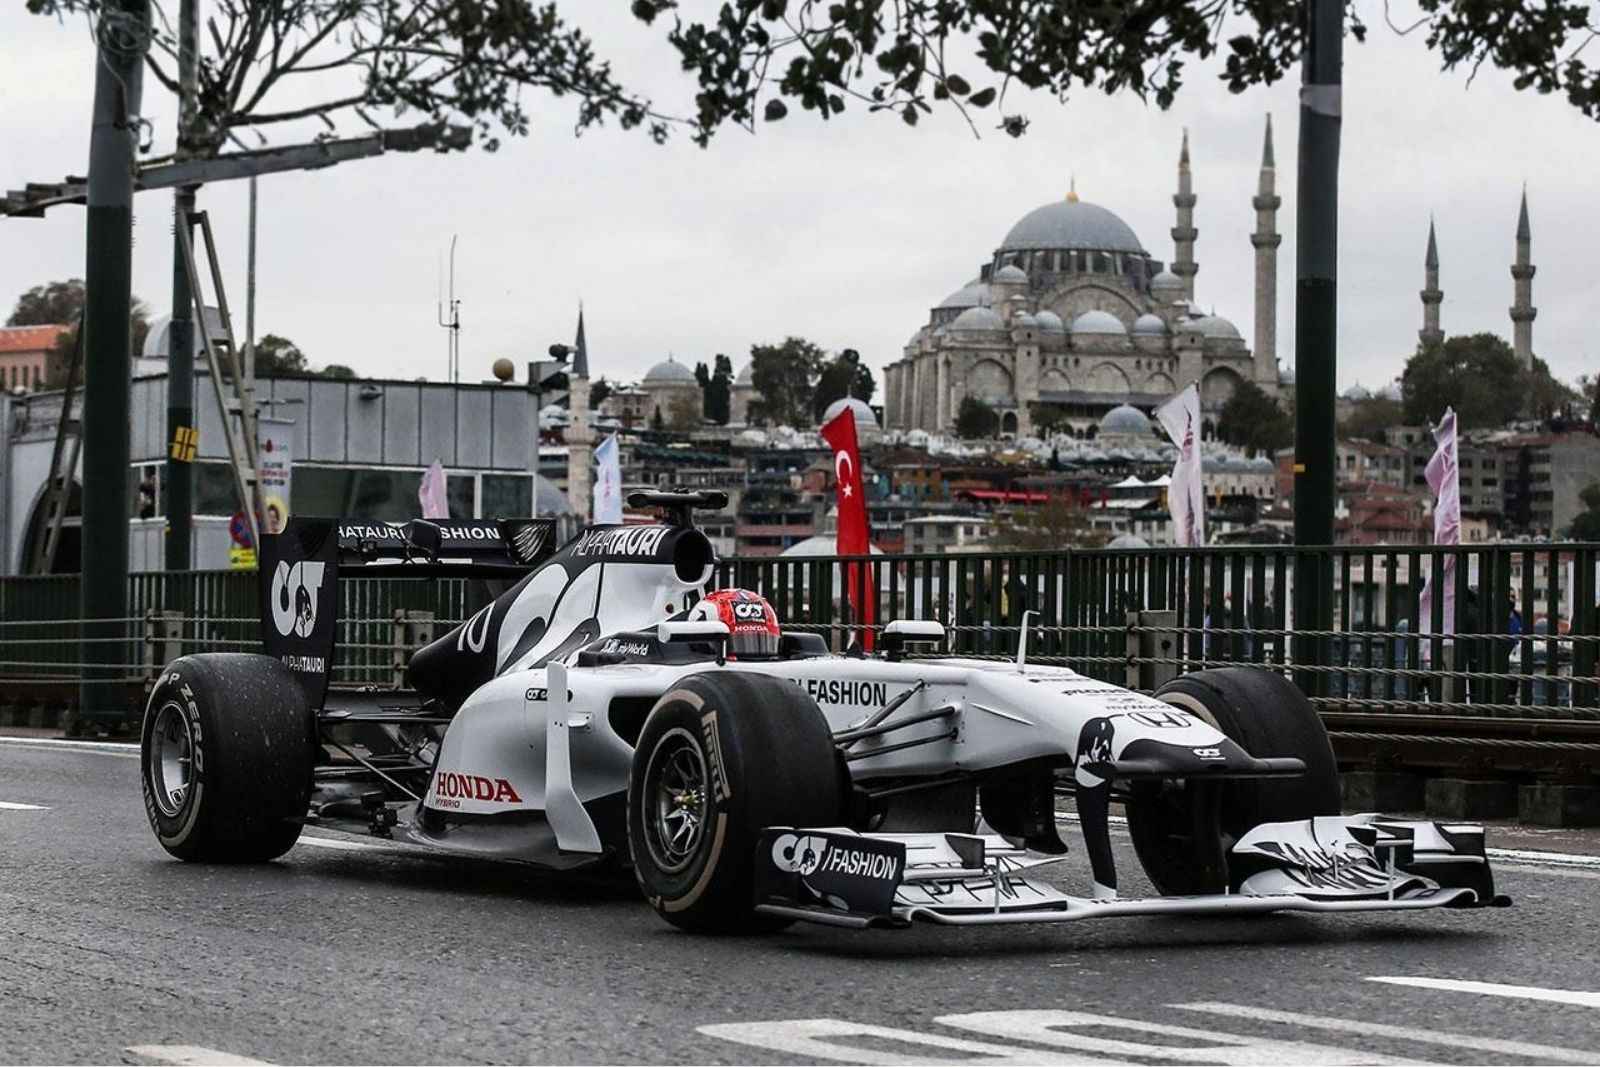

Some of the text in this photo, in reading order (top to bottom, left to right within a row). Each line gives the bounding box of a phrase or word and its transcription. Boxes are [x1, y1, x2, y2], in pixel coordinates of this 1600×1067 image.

[441, 527, 501, 540] SHION
[807, 680, 886, 707] FASHION
[436, 772, 523, 803] HONDA
[435, 799, 460, 809] HYBRID
